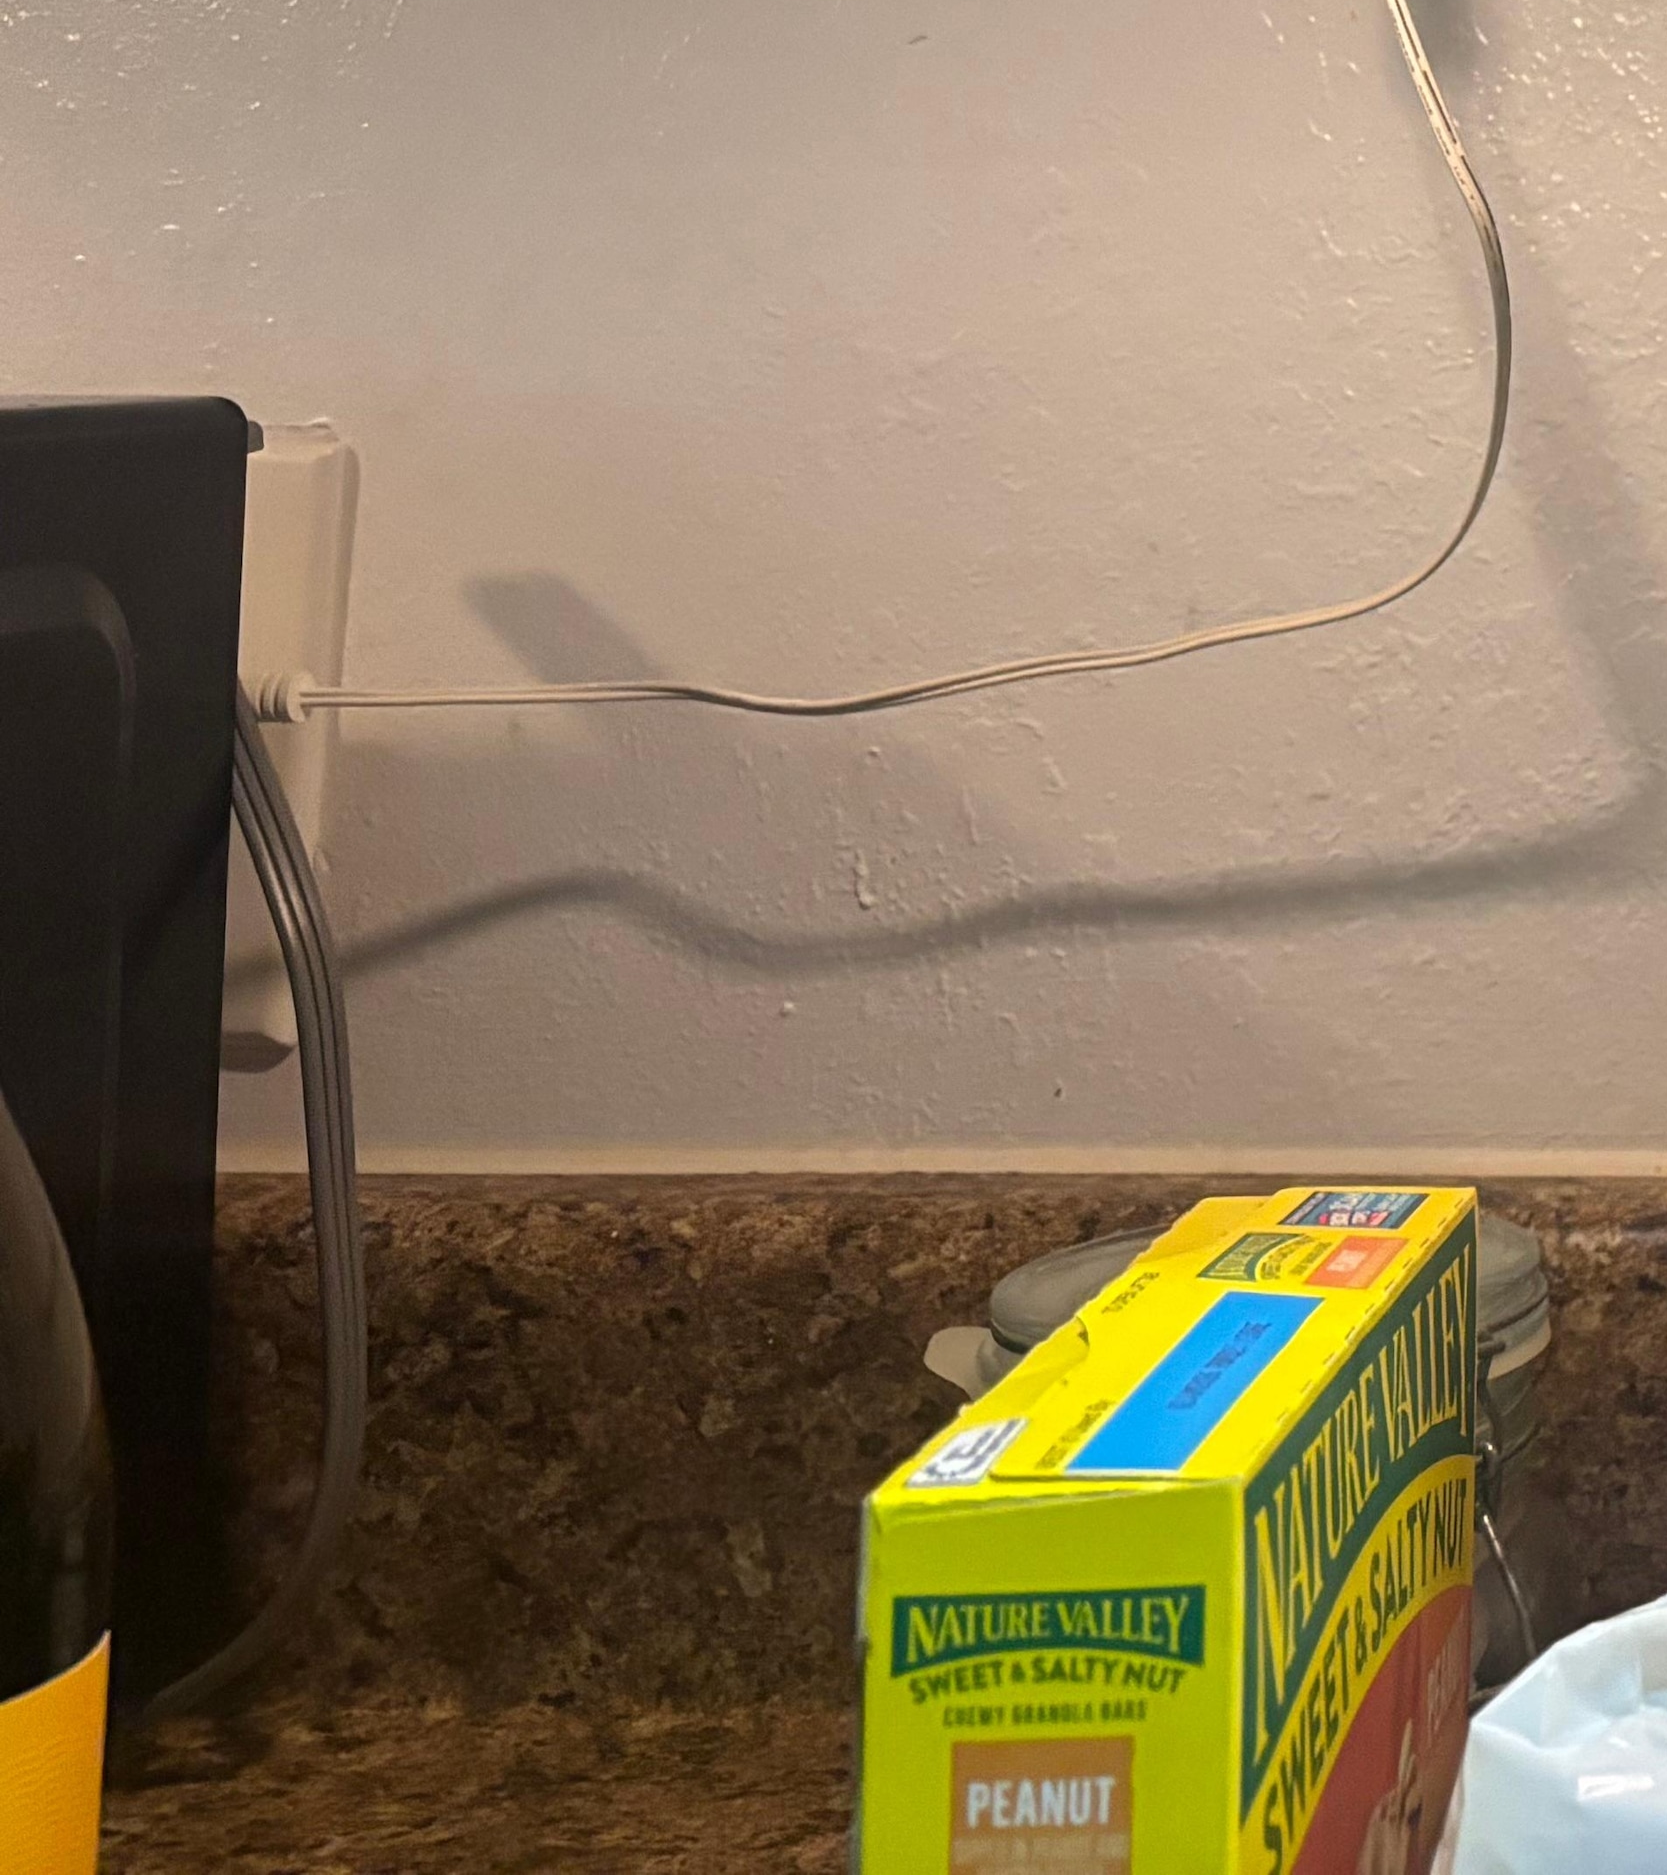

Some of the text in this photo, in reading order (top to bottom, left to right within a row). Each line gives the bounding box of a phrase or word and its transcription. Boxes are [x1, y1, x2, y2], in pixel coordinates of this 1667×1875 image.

[1254, 1362, 1380, 1766] NATURE
[1378, 1243, 1469, 1463] VALLEY
[906, 1594, 1190, 1663] NATURE VALLEY
[908, 1660, 1004, 1705] SWEET
[1031, 1656, 1119, 1685] SALTY
[1121, 1661, 1188, 1695] NUT
[1263, 1608, 1350, 1875] SWEET
[1354, 1596, 1368, 1675] &
[1370, 1491, 1431, 1652] SALTY
[1433, 1478, 1466, 1577] NUT
[966, 1775, 1116, 1829] PEANUT
